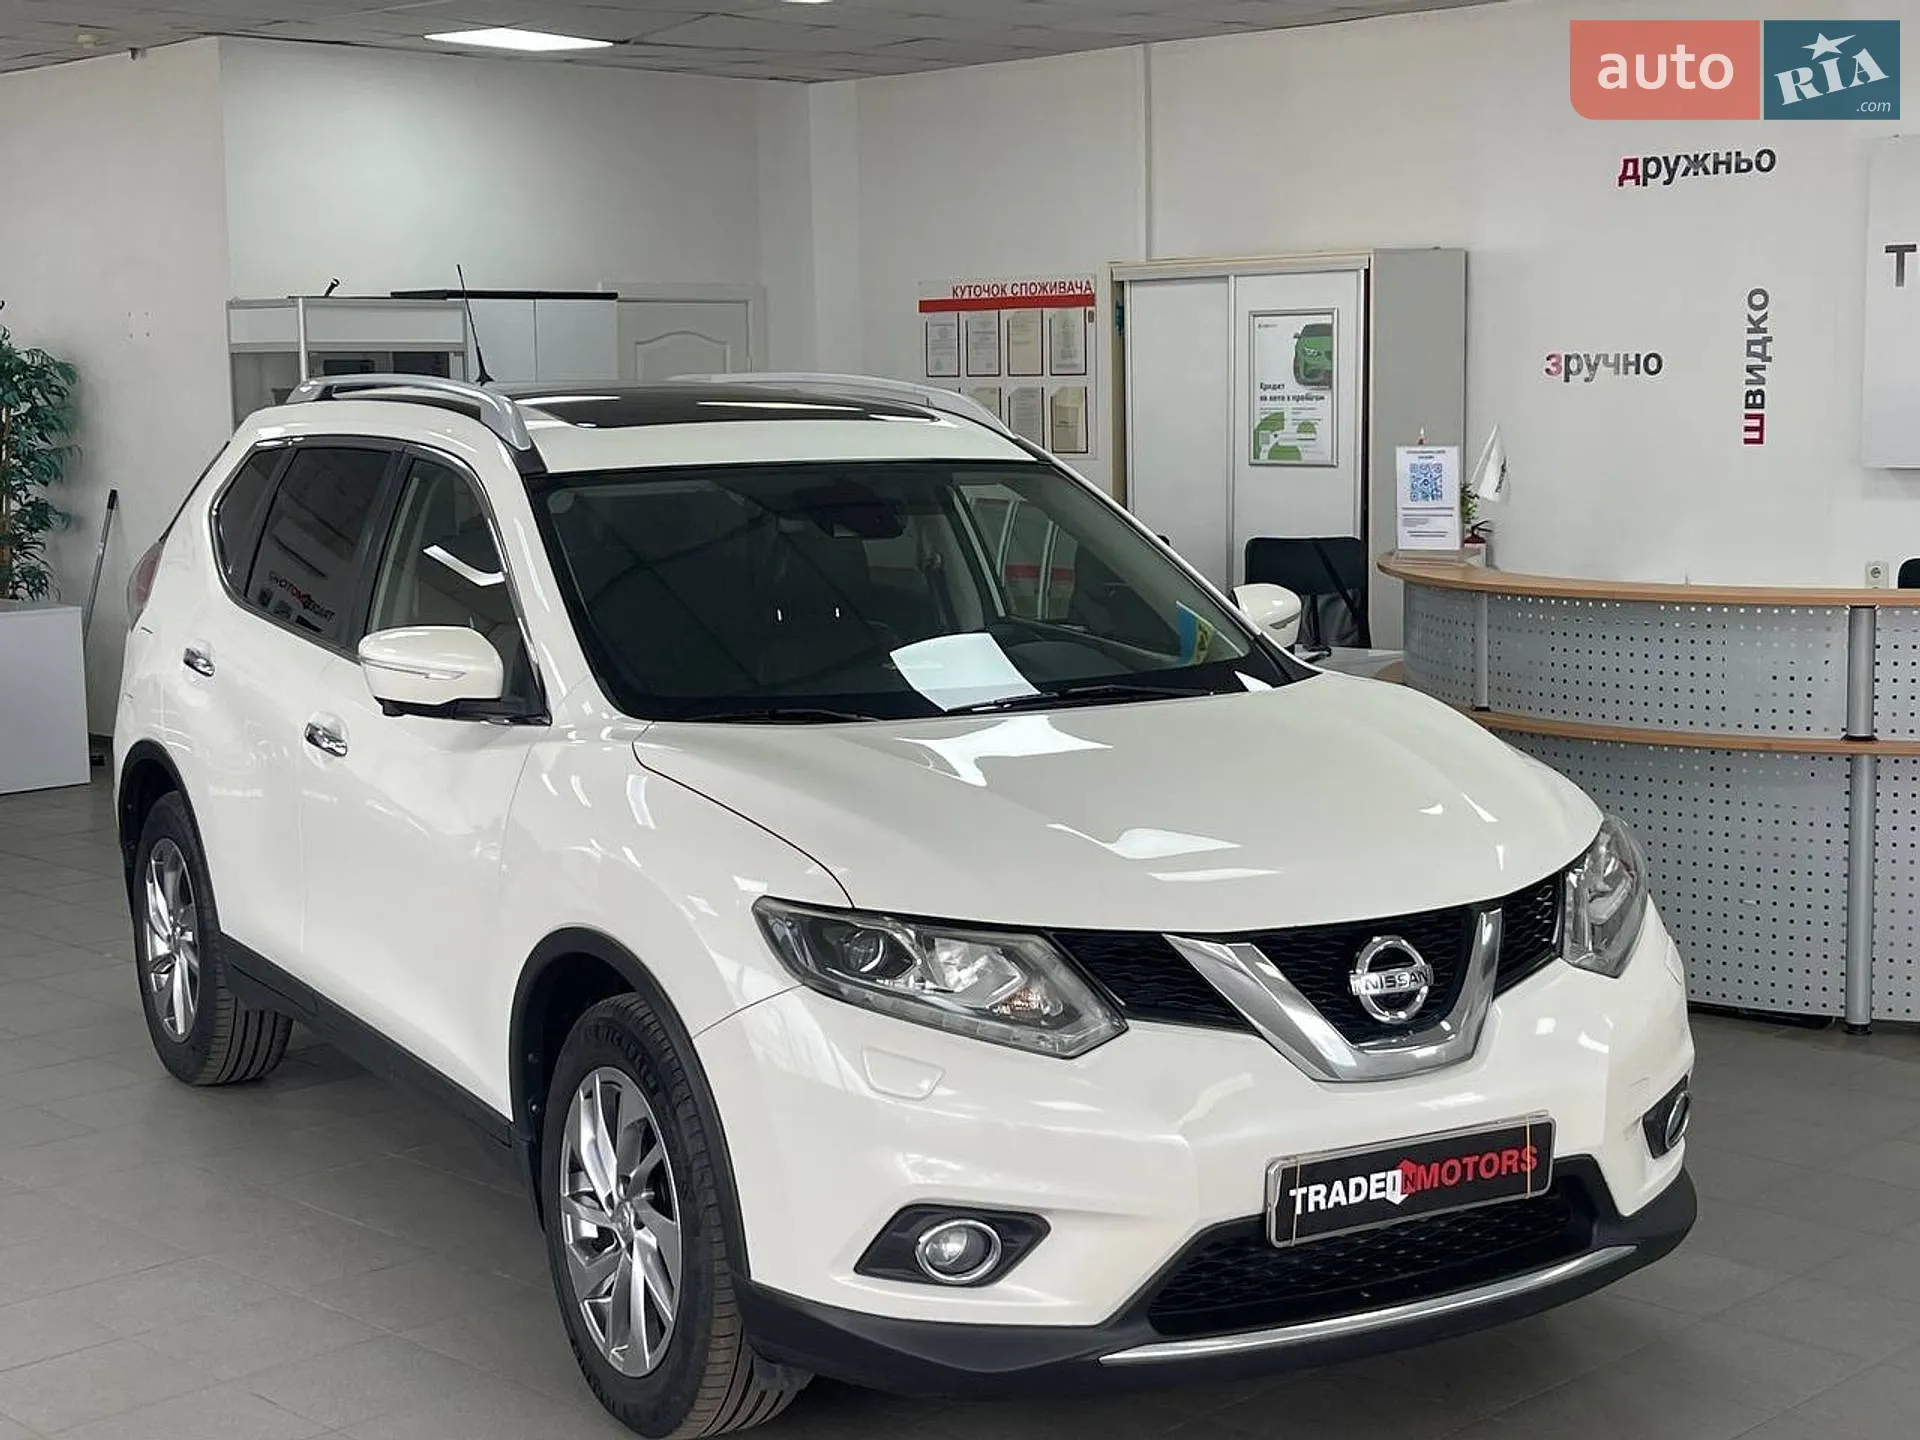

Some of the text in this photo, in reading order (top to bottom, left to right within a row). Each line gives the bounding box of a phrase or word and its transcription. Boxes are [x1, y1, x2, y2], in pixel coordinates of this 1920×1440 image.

[1617, 146, 1777, 187] дружньо
[952, 280, 1093, 298] КУТОЧОК СПОЖИВАЧА
[1545, 352, 1663, 382] зручно
[1743, 287, 1773, 445] швидко
[1365, 969, 1429, 991] NISSAN
